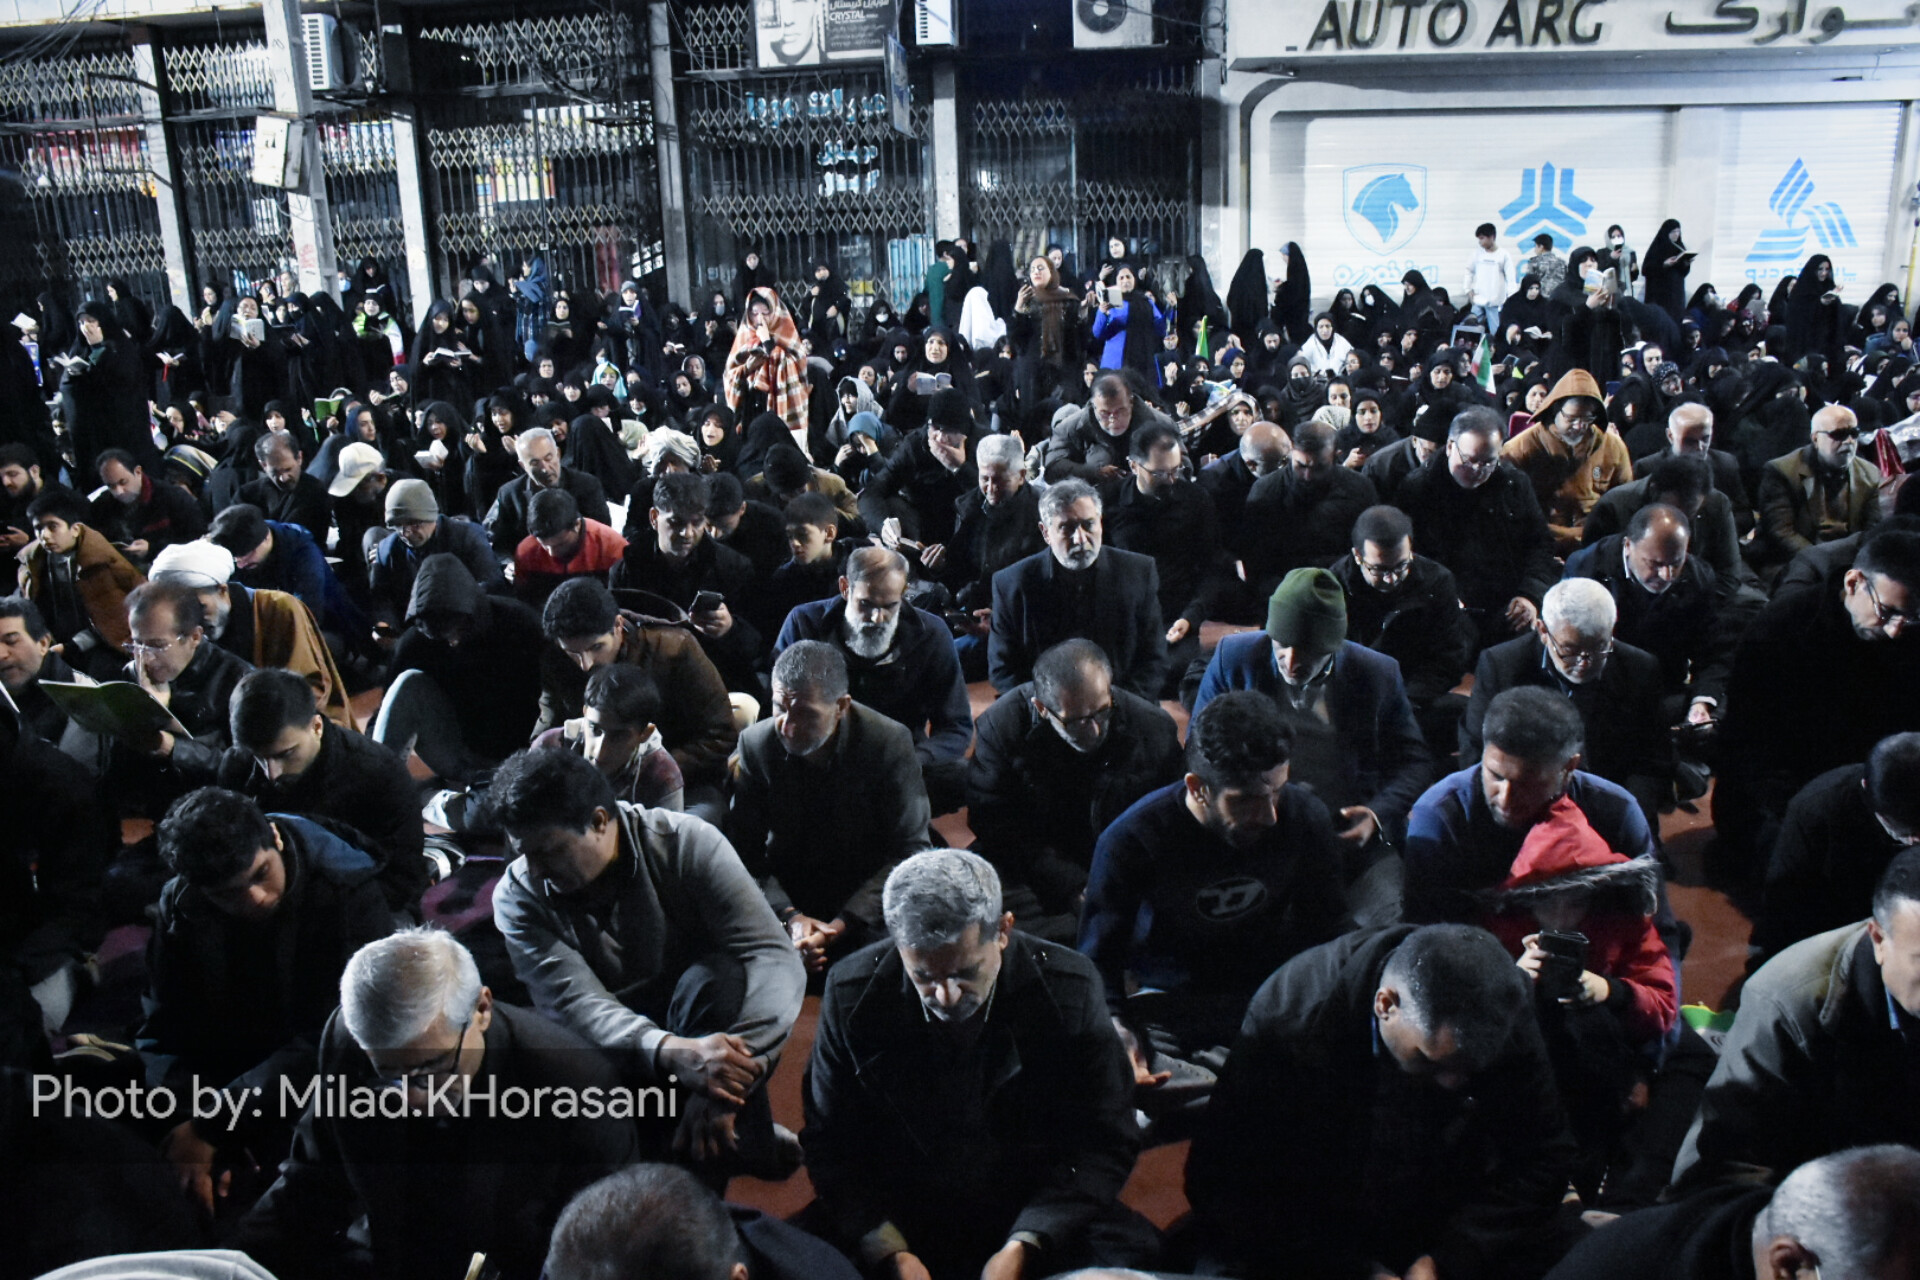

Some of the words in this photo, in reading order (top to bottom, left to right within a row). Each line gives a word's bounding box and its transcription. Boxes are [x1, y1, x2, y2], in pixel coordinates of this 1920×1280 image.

[829, 10, 865, 21] CRYSTAL
[1306, 0, 1469, 50] AUTO
[1486, 0, 1603, 48] ARG
